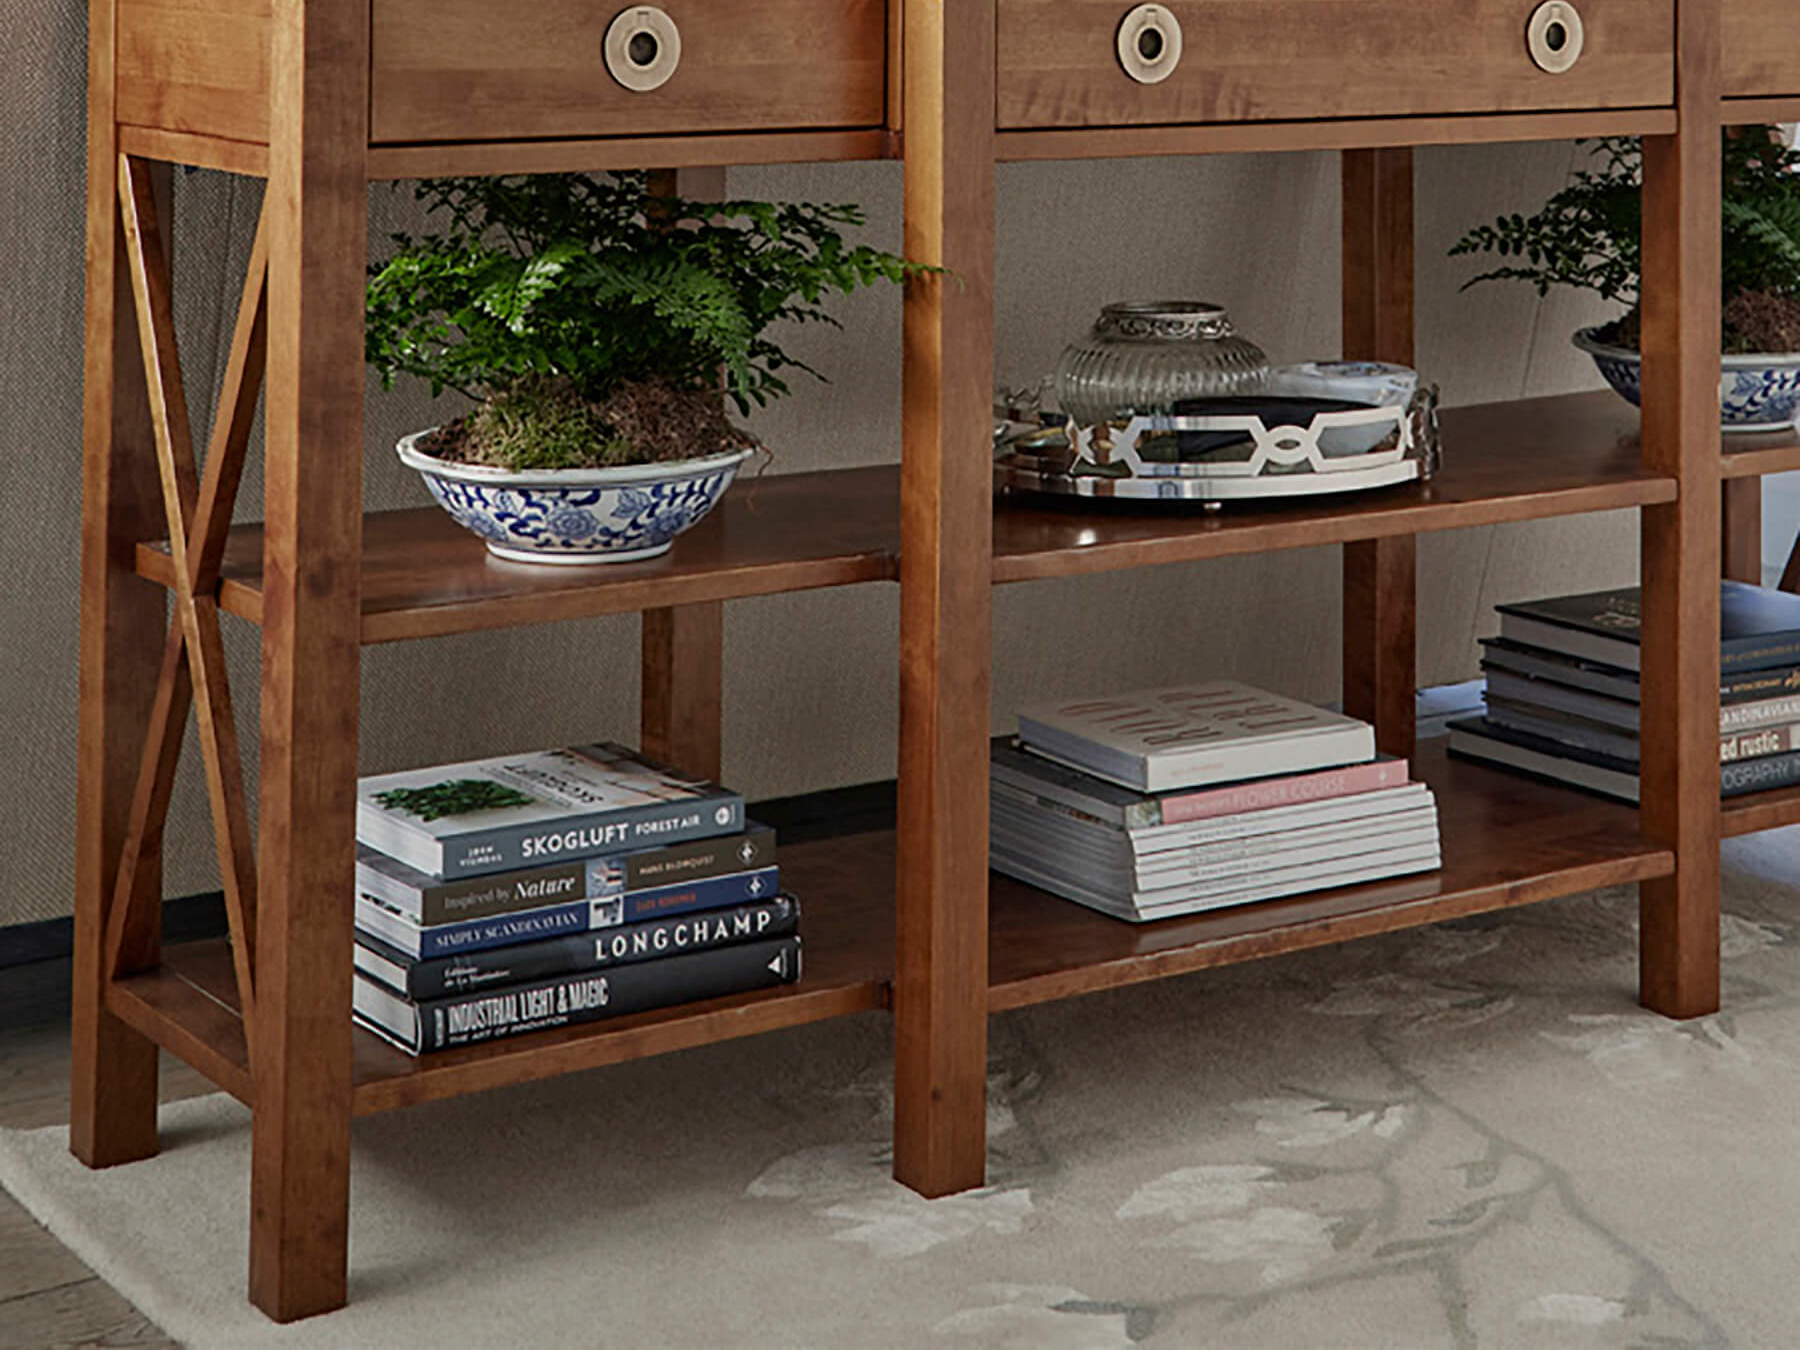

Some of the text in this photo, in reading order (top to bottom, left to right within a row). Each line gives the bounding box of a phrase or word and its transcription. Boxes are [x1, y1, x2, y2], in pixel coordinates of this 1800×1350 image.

[1740, 731, 1780, 755] rustic
[522, 814, 700, 857] SKOGLUFT FOREST AIR
[444, 877, 576, 910] Inspired by Nature
[435, 911, 579, 948] SIMPLY SCANDINAVIAN
[595, 910, 771, 961] LONGCHAMP
[448, 994, 519, 1034] INDUSTRIAL
[519, 987, 555, 1021] LIGHT
[556, 985, 569, 1014] &
[569, 978, 609, 1011] MAGIC
